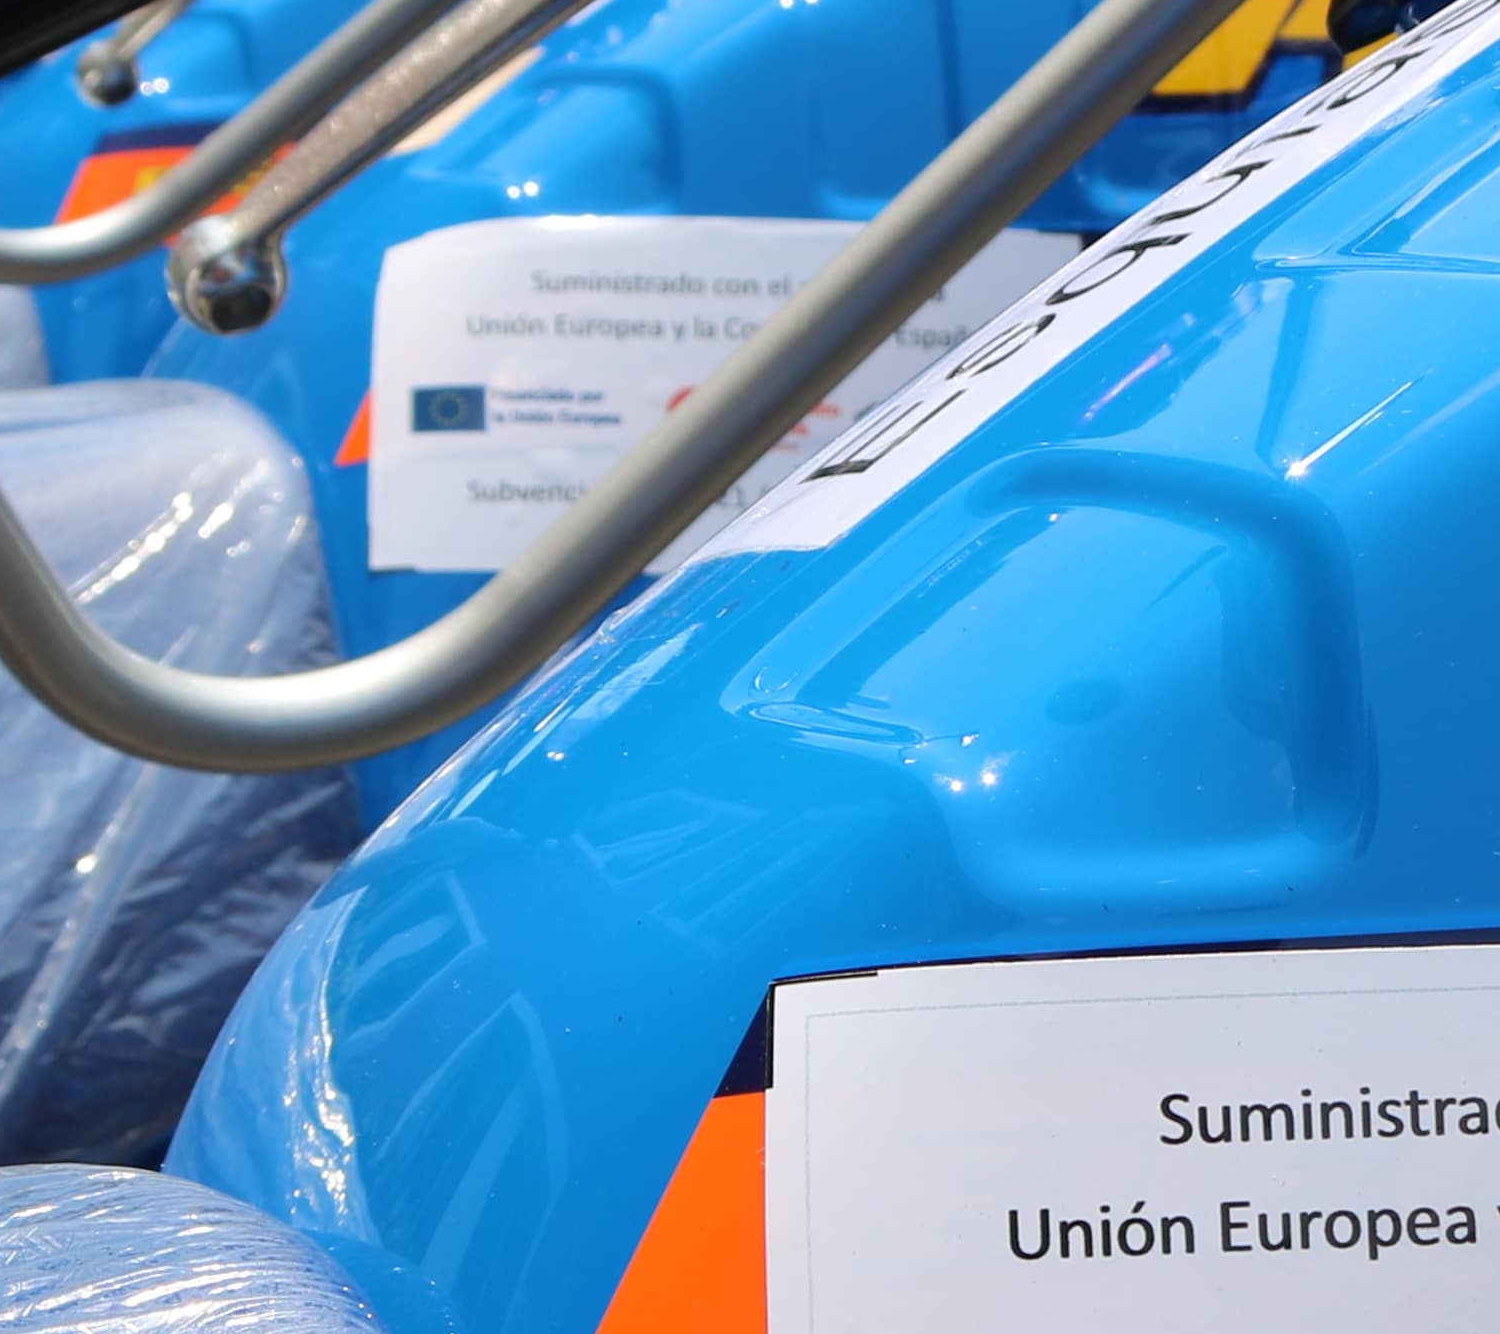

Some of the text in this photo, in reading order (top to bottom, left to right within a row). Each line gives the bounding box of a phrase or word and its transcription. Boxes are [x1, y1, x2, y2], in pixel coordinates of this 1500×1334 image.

[531, 270, 704, 296] Suministrado
[1008, 1200, 1196, 1261] Unión
[1219, 1200, 1477, 1262] Europea
